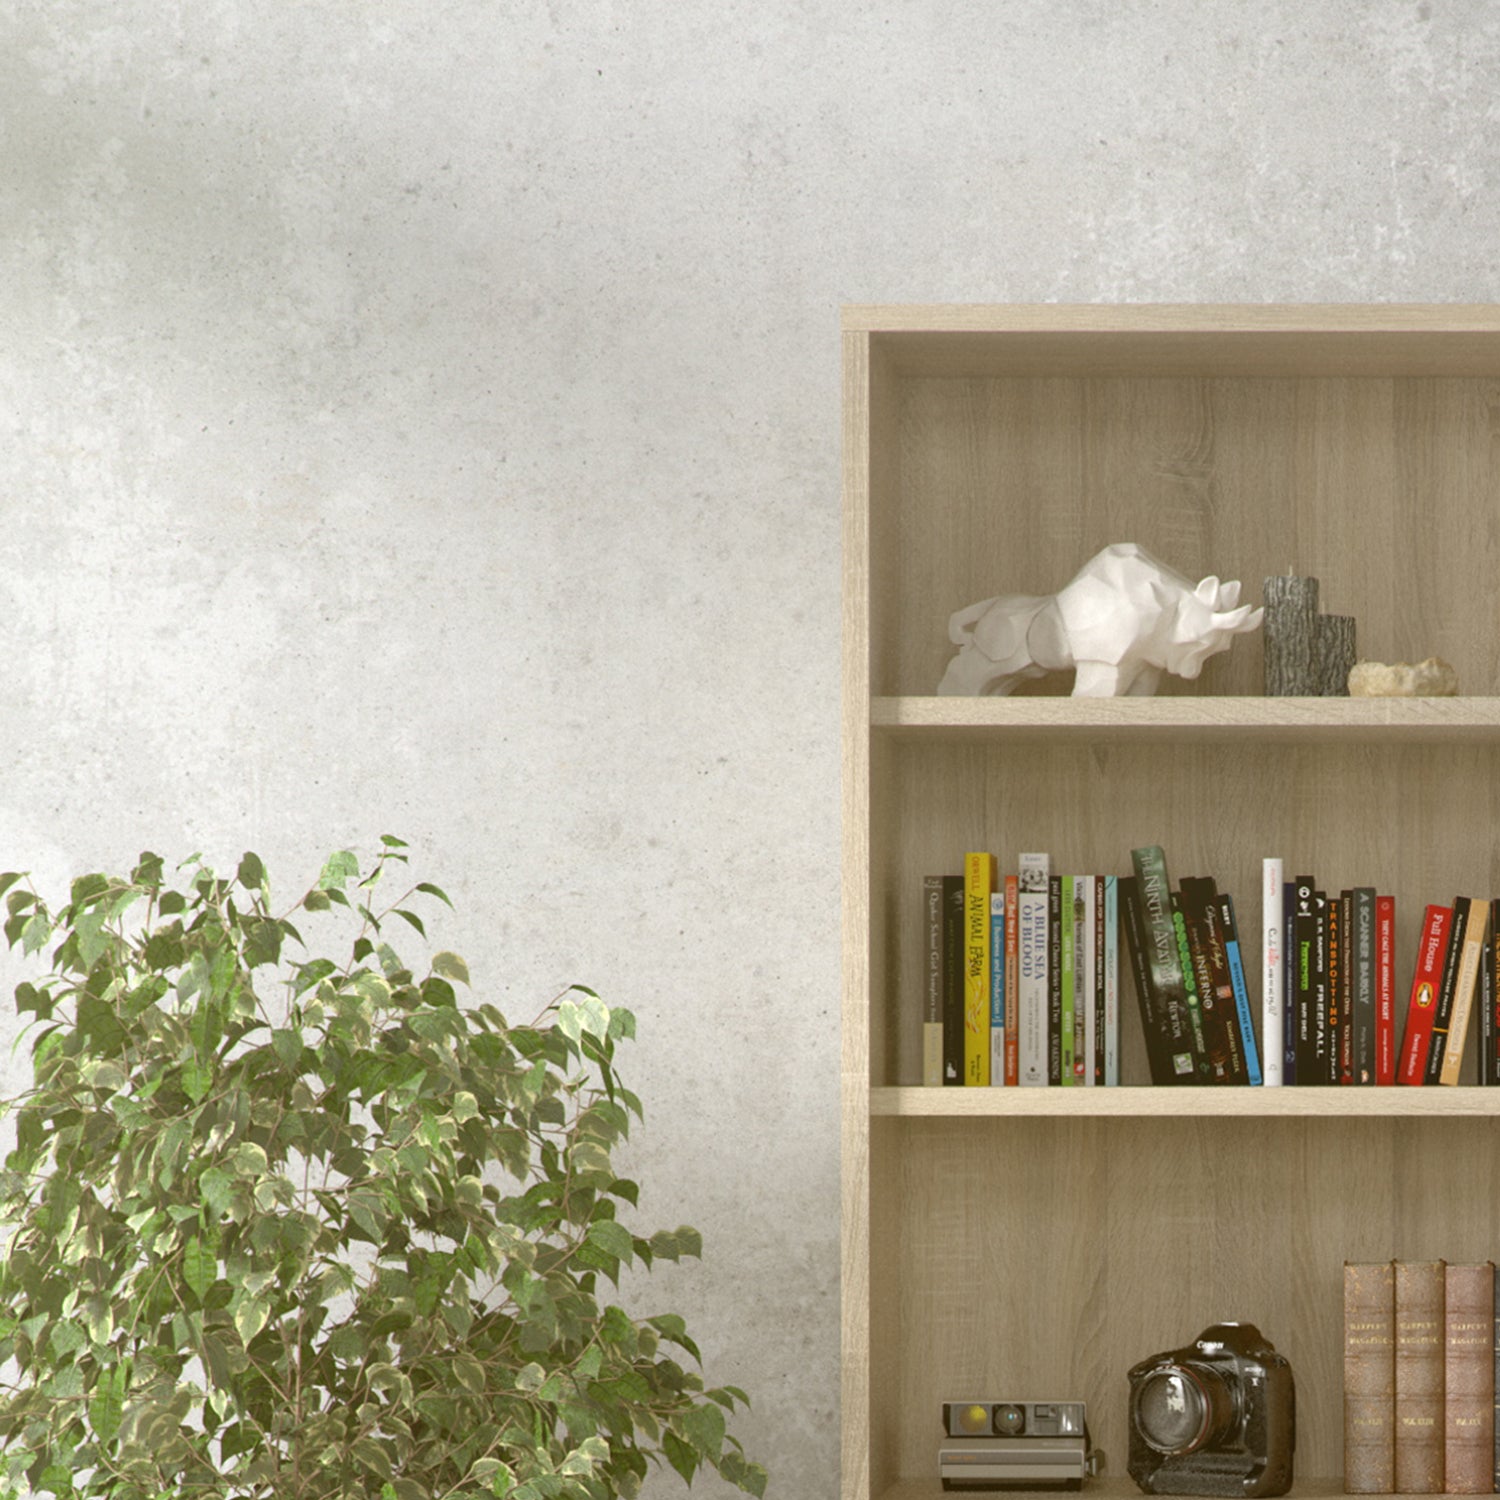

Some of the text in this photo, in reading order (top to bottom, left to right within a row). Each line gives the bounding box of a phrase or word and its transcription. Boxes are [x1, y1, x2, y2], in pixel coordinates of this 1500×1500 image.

[971, 856, 981, 892] ORWELL
[1143, 875, 1166, 925] NINTH
[969, 894, 985, 977] ANIMAL FARM
[993, 926, 1003, 1015] Business and Production
[1022, 905, 1033, 977] OF BLOOD
[1035, 902, 1046, 980] A BLUE SEA
[1153, 930, 1175, 986] AVATAR
[1329, 902, 1338, 1026] TRAINSPOTTING
[1360, 892, 1370, 1004] A SCANNER DARKLY
[1424, 913, 1444, 972] Full House
[1196, 955, 1214, 1009] INFERNO
[1051, 1033, 1060, 1079] AWAKENING
[1316, 984, 1325, 1059] FREEFALL
